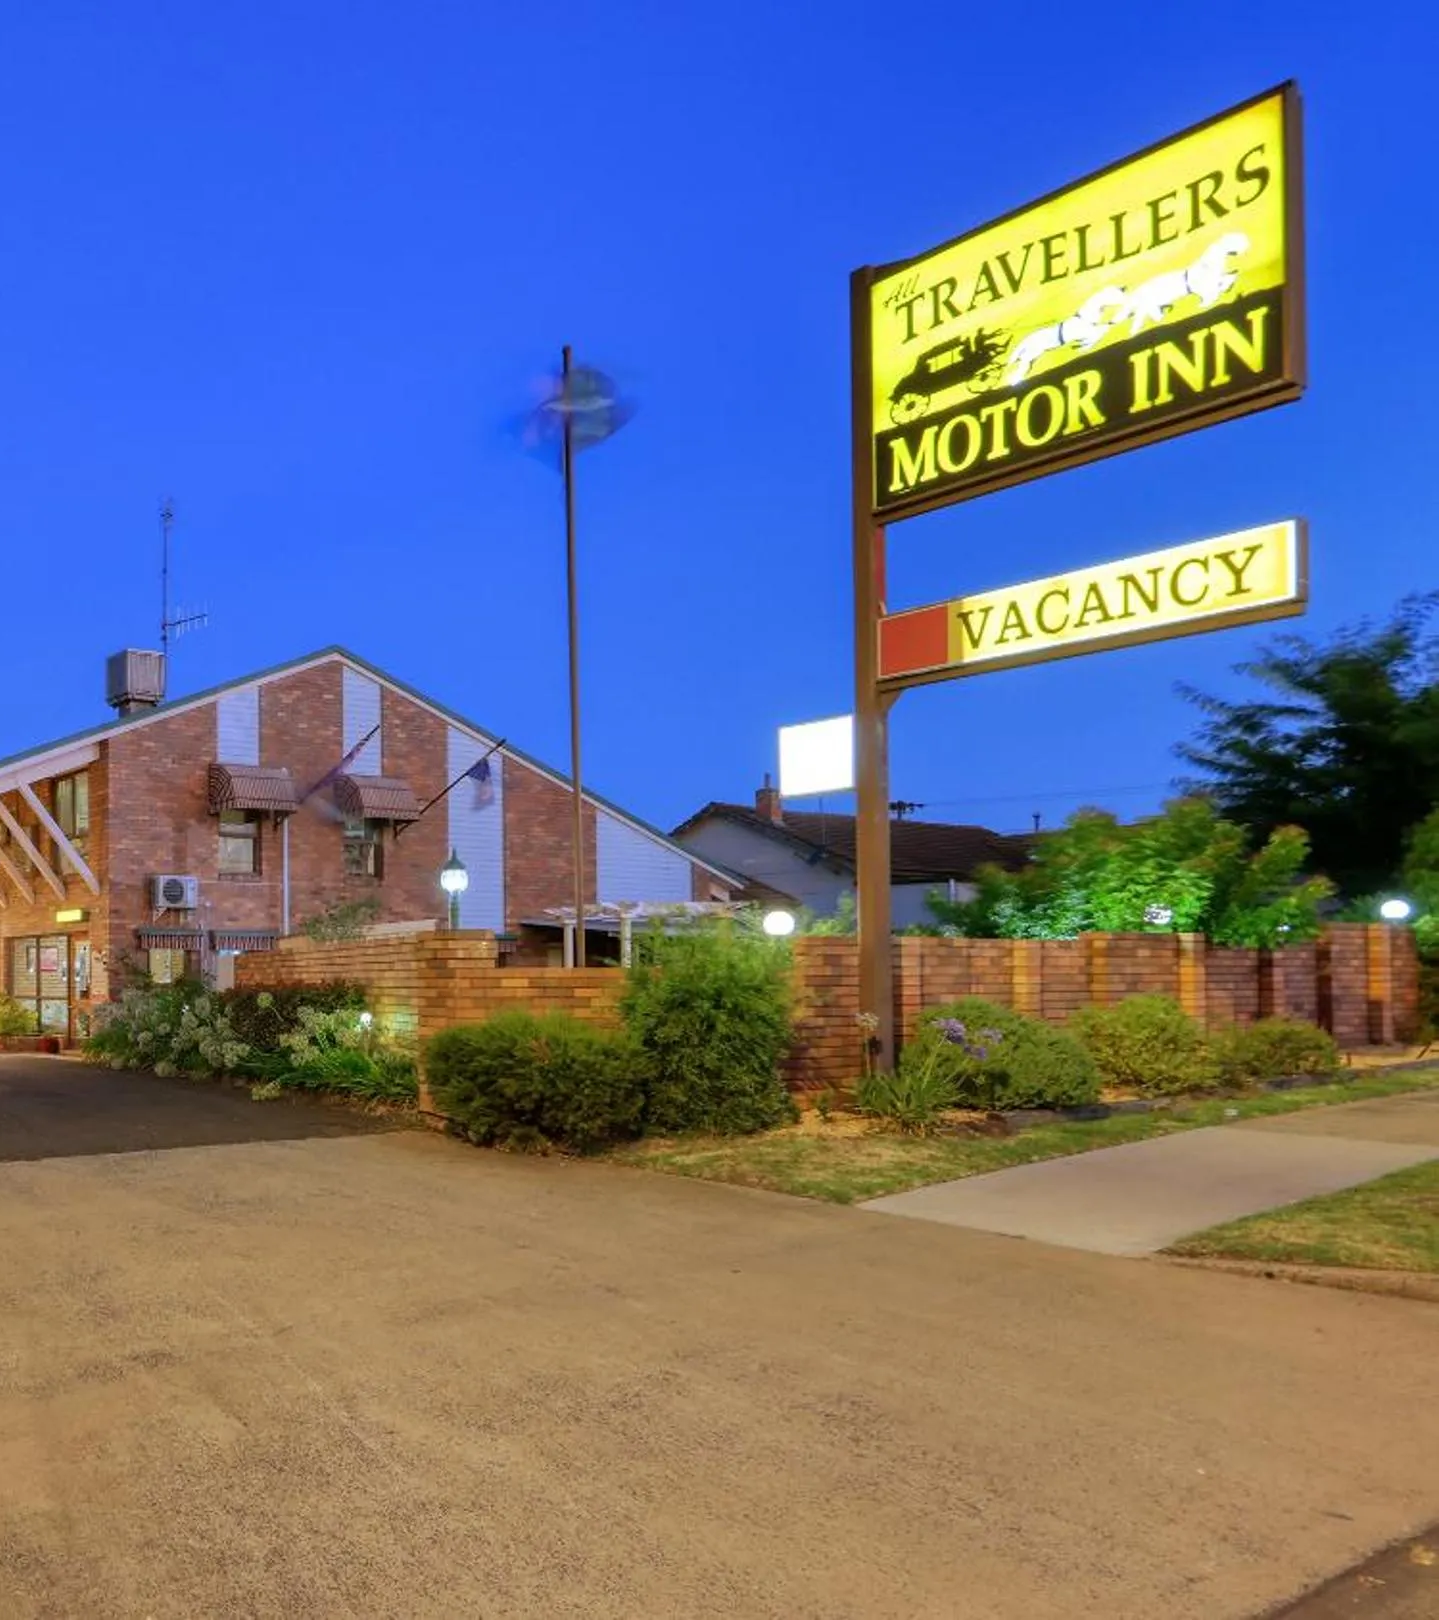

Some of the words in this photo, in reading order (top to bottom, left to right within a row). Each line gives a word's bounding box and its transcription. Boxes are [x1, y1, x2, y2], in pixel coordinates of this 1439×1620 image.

[896, 144, 1271, 345] TRAVELLERS
[888, 369, 1106, 493] MOTOR
[1128, 306, 1269, 413] INN
[957, 544, 1264, 650] VACANCY
